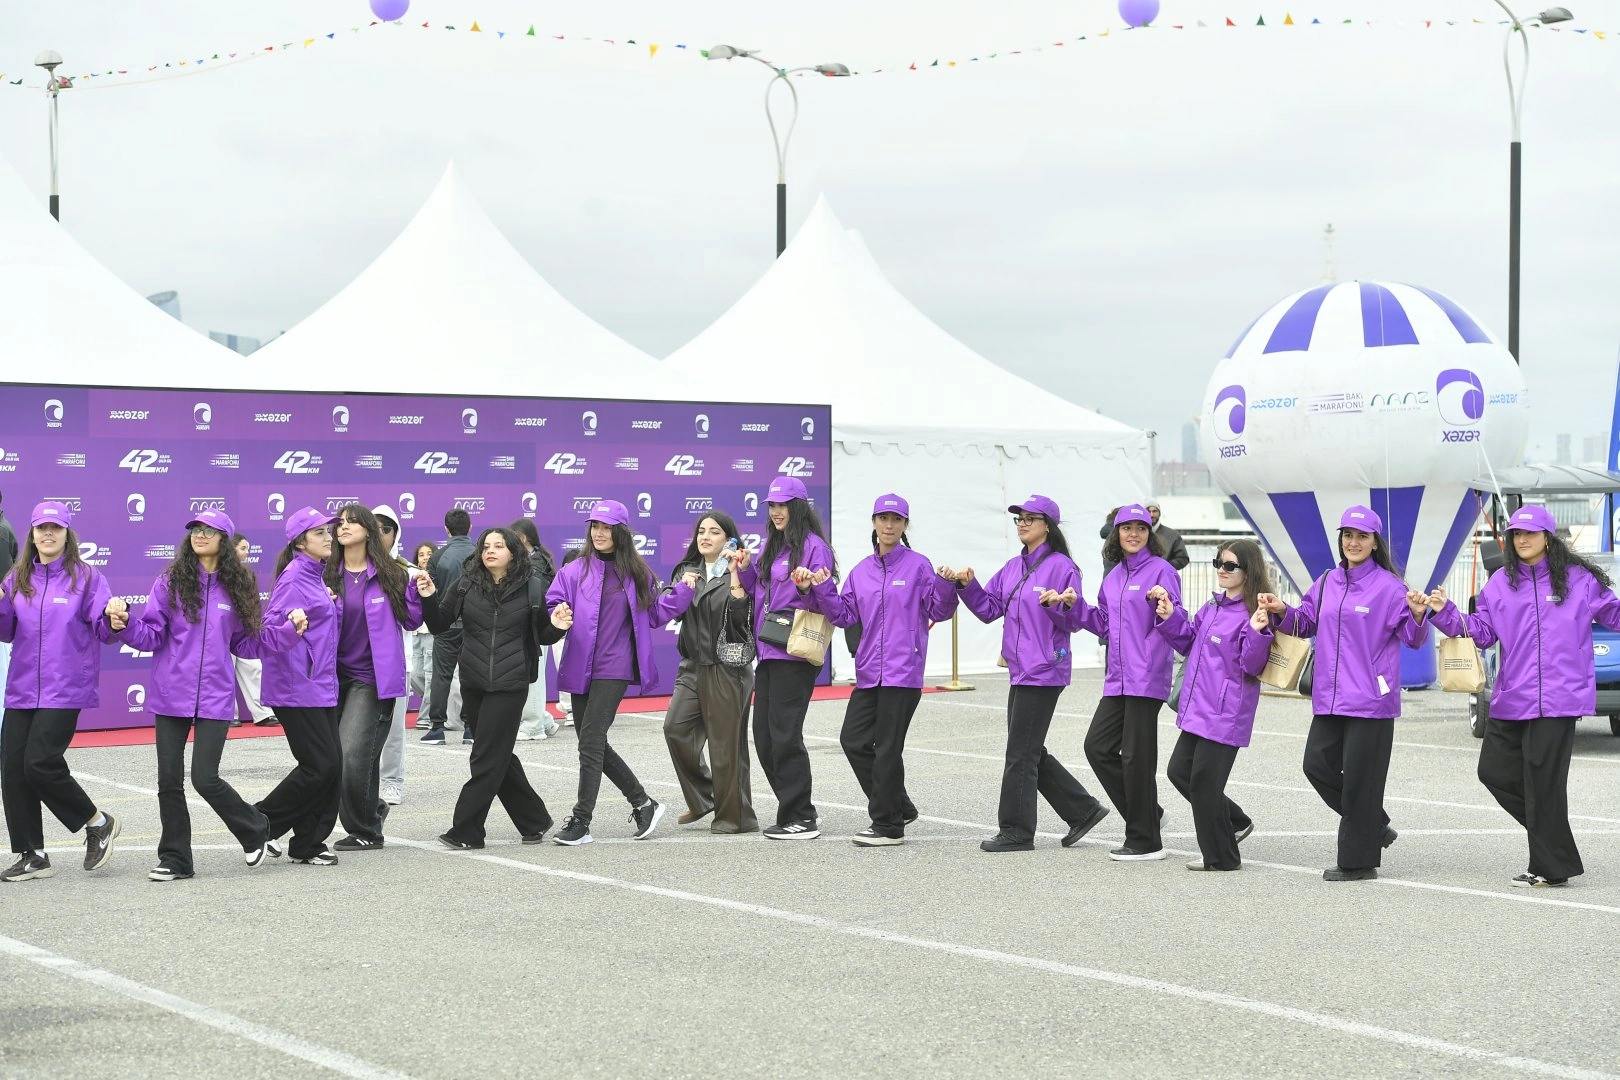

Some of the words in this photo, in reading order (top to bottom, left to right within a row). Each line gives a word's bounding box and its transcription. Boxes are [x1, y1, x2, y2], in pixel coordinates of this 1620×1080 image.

[1320, 400, 1364, 411] MARAFONU
[1442, 430, 1480, 442] XƏZƏR
[119, 450, 159, 473] 42
[1218, 444, 1247, 458] XƏZƏR
[274, 451, 310, 474] 42
[414, 452, 448, 474] 42
[544, 453, 576, 474] 42
[665, 455, 695, 476] 42
